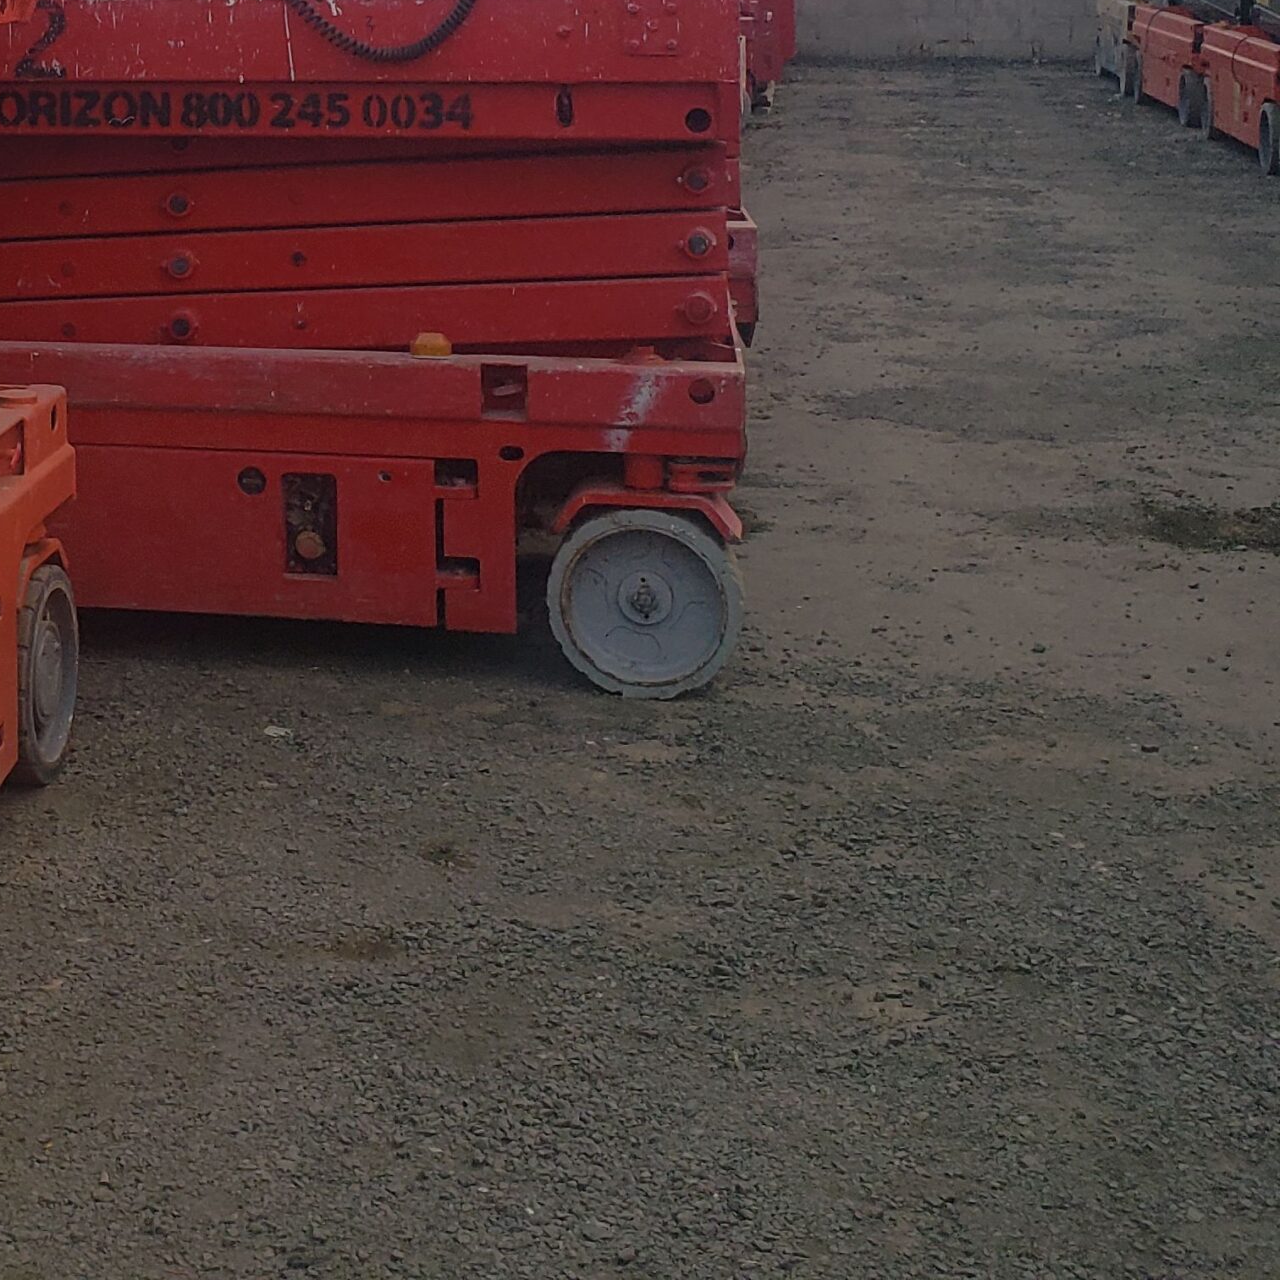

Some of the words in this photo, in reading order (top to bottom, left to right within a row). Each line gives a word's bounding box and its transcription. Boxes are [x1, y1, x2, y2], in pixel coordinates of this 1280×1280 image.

[180, 91, 261, 128] 800
[270, 91, 350, 128] 245
[362, 92, 474, 129] 0034
